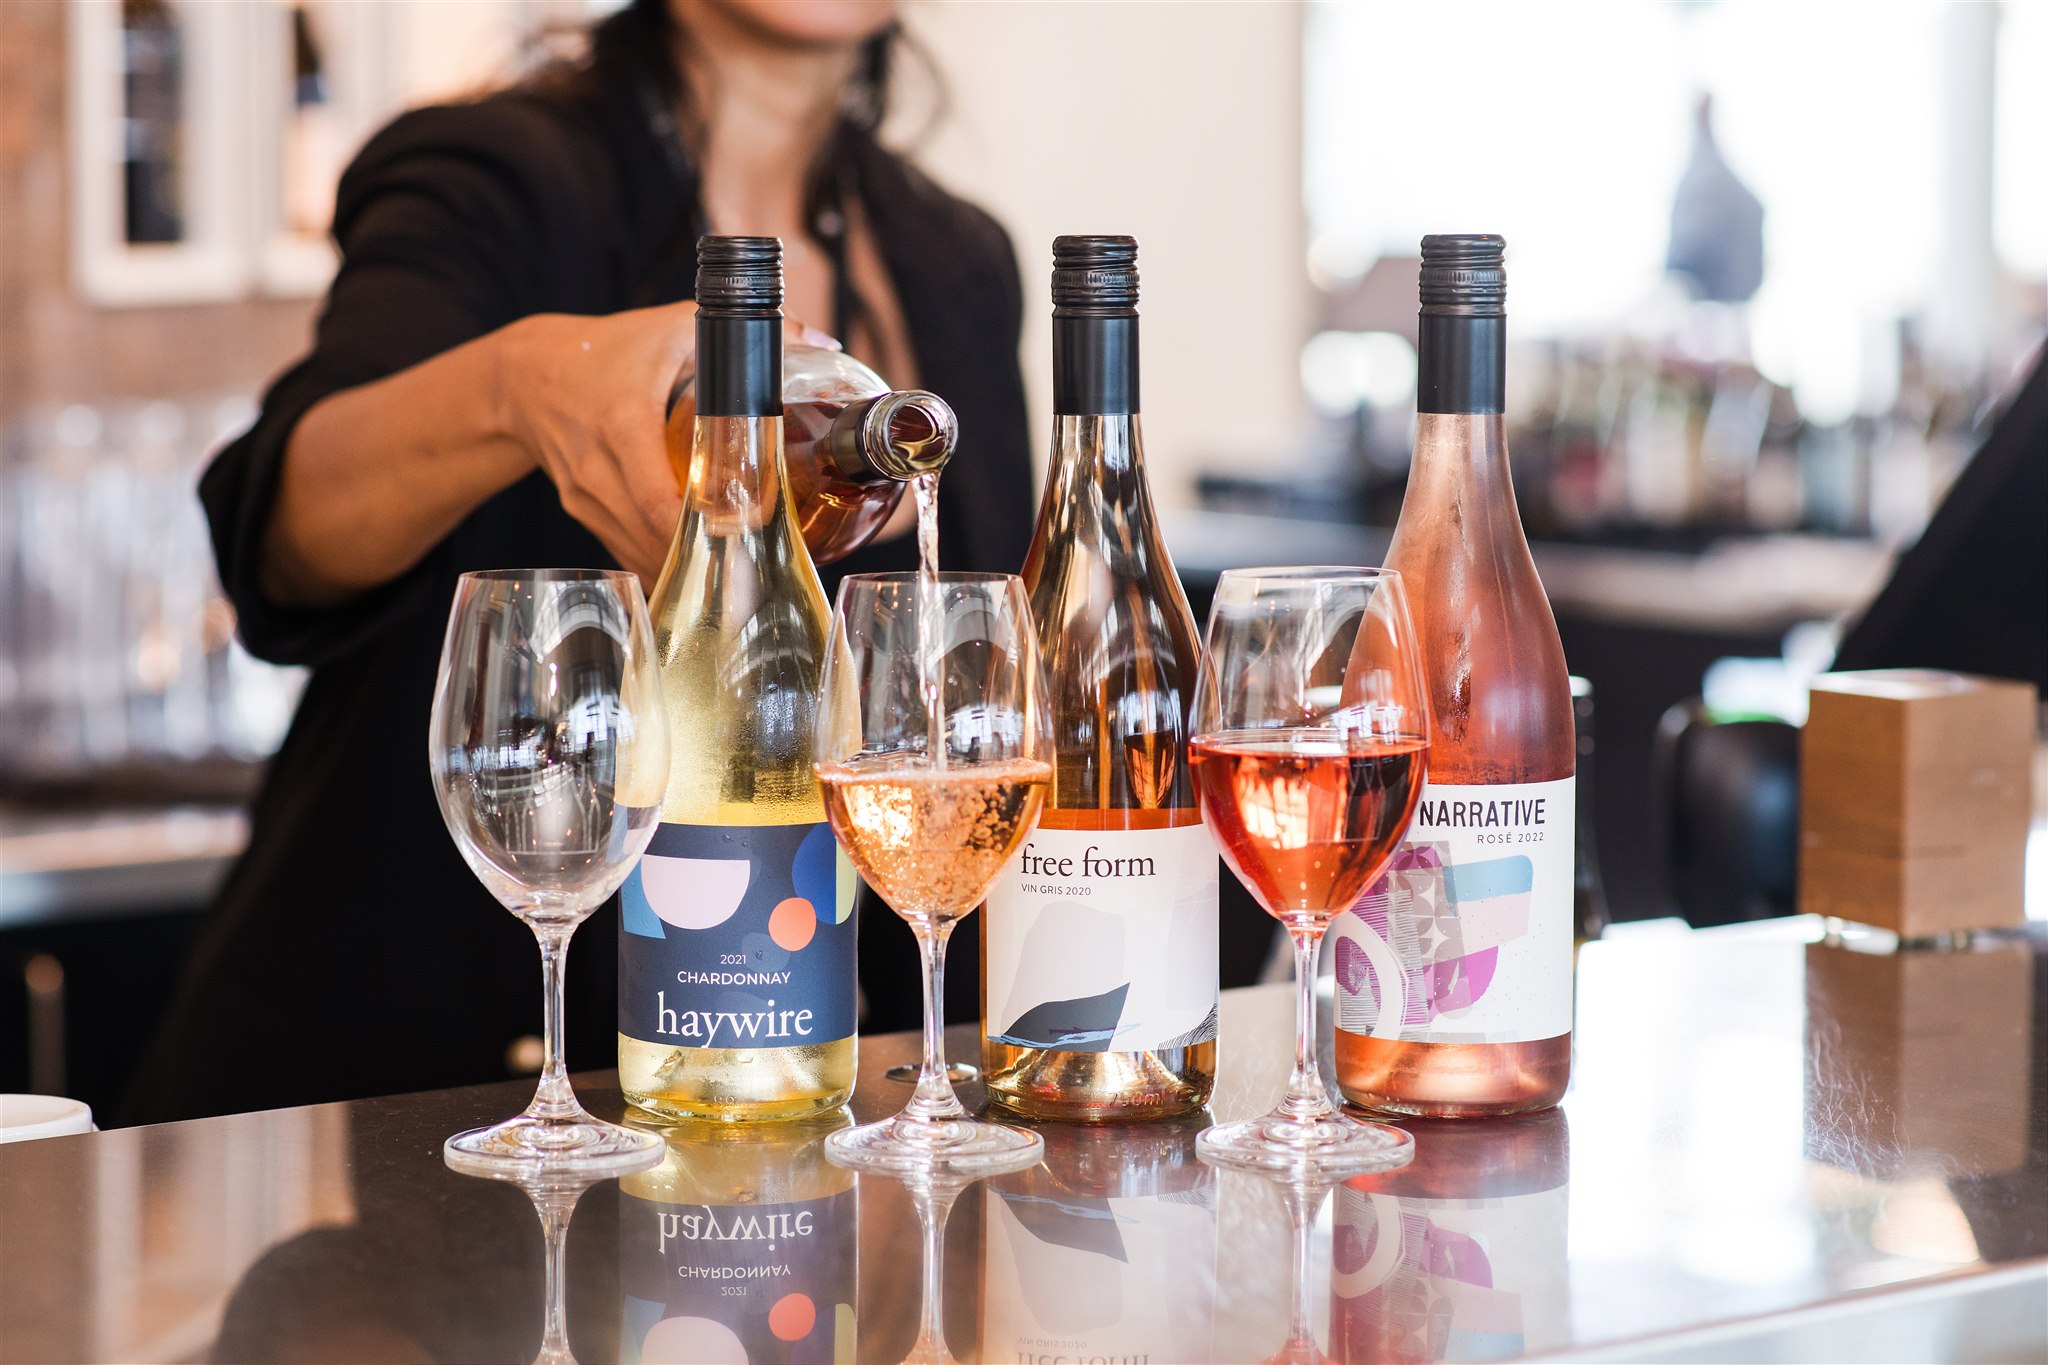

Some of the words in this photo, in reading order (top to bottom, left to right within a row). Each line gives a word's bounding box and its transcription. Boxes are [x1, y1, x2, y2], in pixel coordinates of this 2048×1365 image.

[1419, 798, 1545, 827] NARRATIVE
[1477, 831, 1513, 845] ROSÉ
[1518, 831, 1545, 844] 2022
[1021, 843, 1073, 877] free
[1082, 846, 1156, 878] form
[1020, 883, 1038, 894] VIN
[1039, 885, 1064, 896] GRIS
[1065, 886, 1092, 896] 2020
[720, 954, 747, 965] 2021
[677, 970, 791, 986] CHARDONNAY
[656, 991, 813, 1049] haywire
